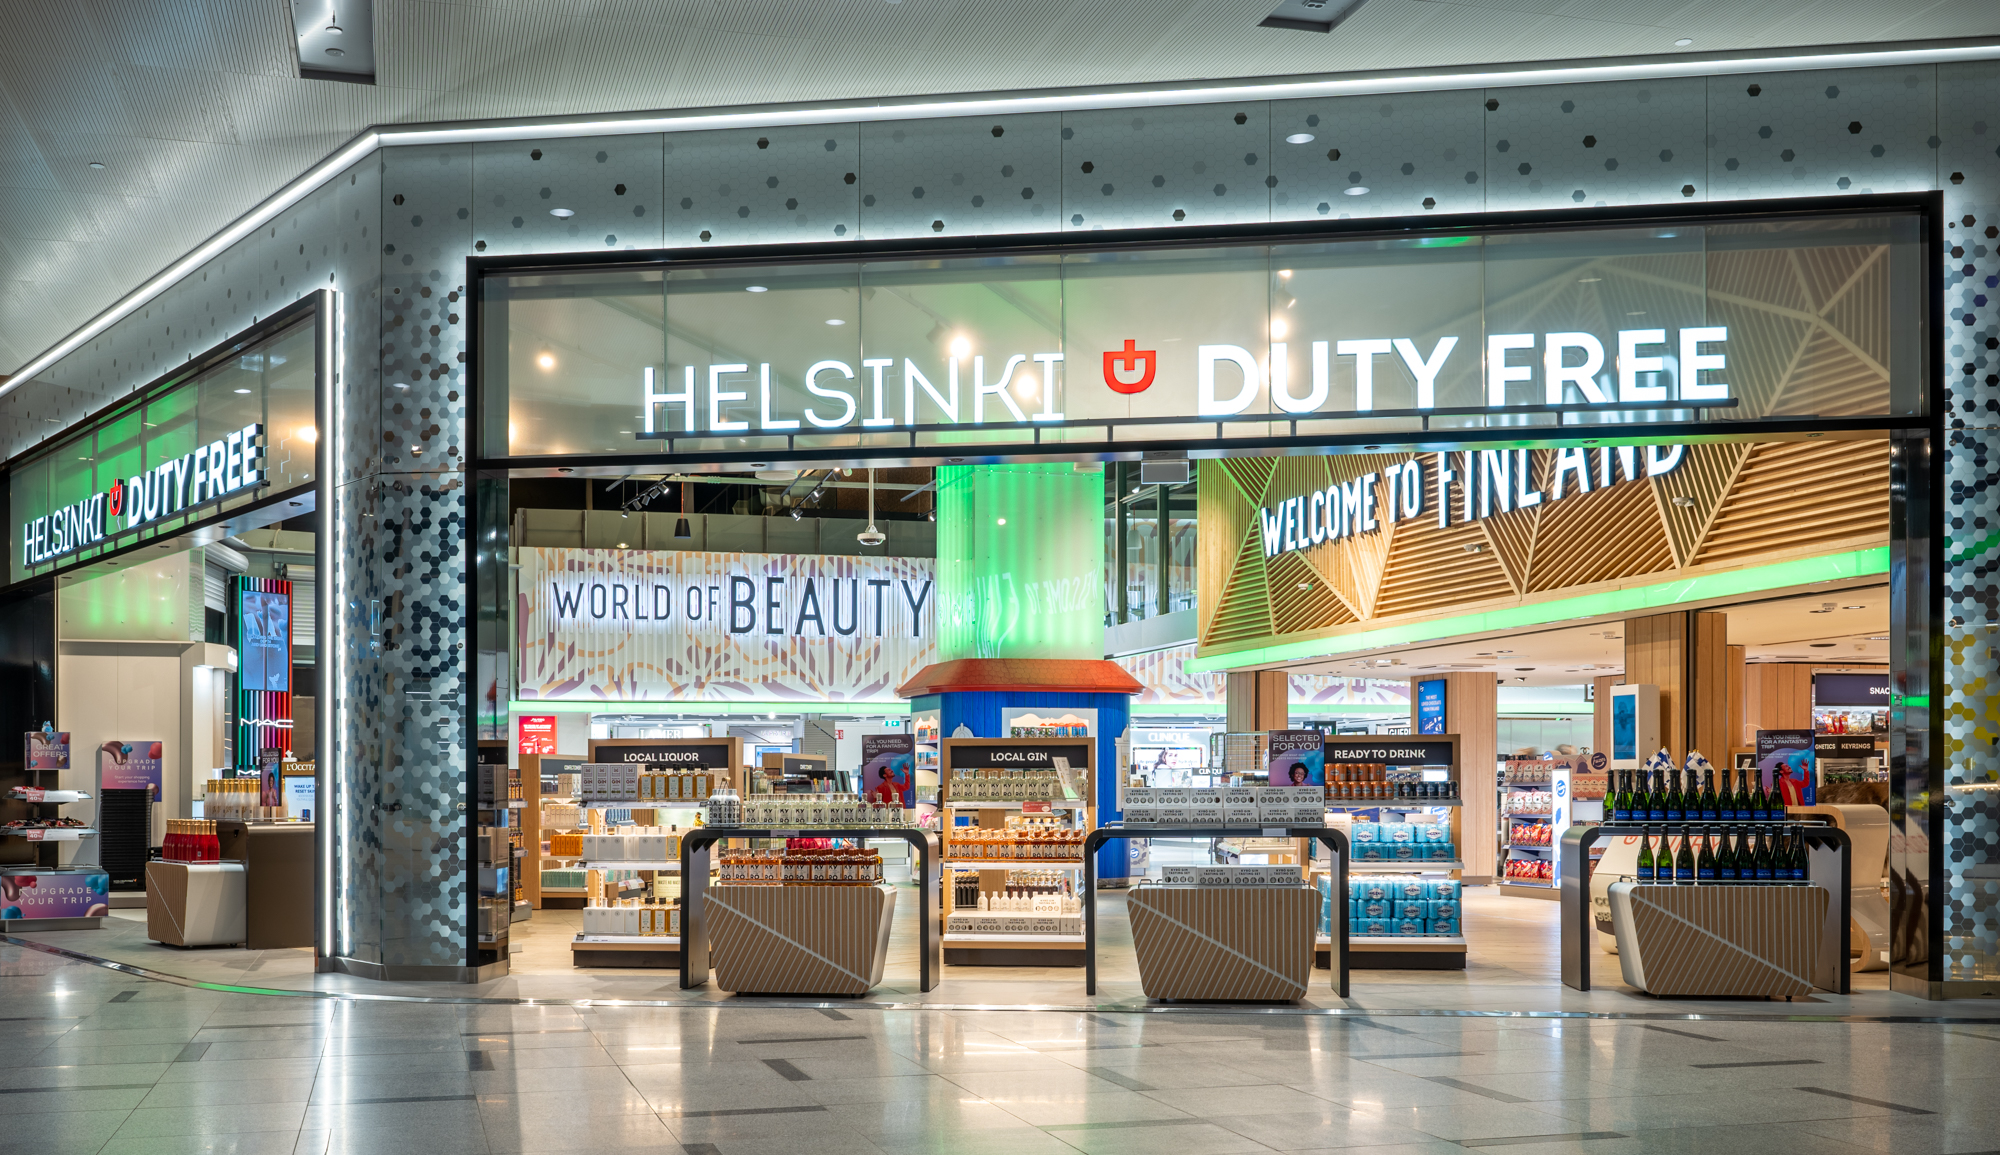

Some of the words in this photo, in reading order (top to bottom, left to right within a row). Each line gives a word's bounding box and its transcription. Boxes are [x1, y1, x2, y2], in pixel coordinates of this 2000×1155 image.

[644, 353, 1064, 433] HELSINKI
[1198, 336, 1458, 416] DUTY
[1488, 326, 1729, 407] FREE
[24, 492, 106, 565] HELSINKI
[127, 454, 193, 528] DUTY
[194, 423, 262, 503] FREE
[1261, 473, 1377, 557] WELCOME
[1385, 460, 1422, 523] TO
[1437, 445, 1687, 529] FINLAND
[552, 582, 671, 620] WORLD
[687, 586, 720, 621] OF
[730, 575, 932, 636] BEAUTY
[240, 718, 293, 728] MAC
[1148, 732, 1190, 743] CLINIQUE
[1273, 742, 1295, 750] FOR
[1297, 742, 1320, 750] YOU
[624, 753, 657, 762] LOCAL
[659, 752, 699, 762] LIQUOR
[991, 753, 1025, 761] LOCAL
[1027, 752, 1047, 761] GIN
[1334, 750, 1370, 759] READY
[1371, 749, 1386, 759] TO
[1389, 749, 1425, 758] DRINK
[32, 887, 92, 895] UPGRADE
[19, 897, 54, 905] YOUR
